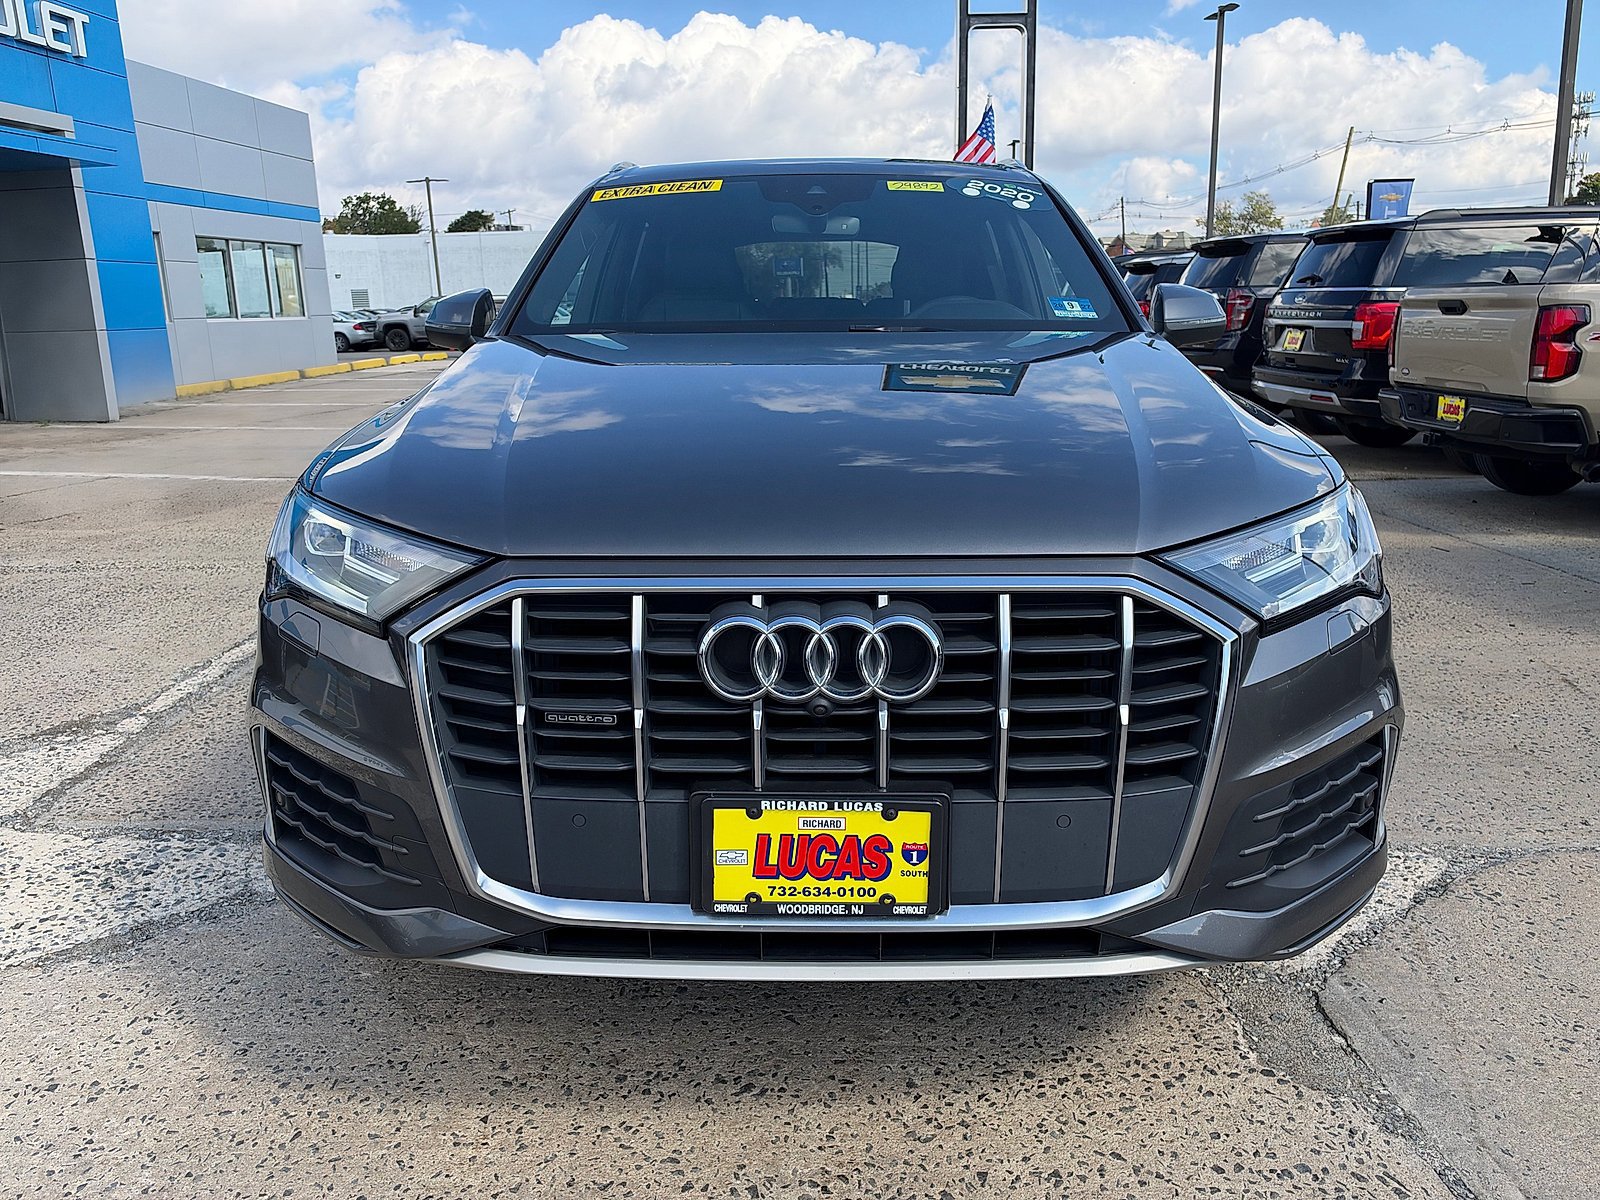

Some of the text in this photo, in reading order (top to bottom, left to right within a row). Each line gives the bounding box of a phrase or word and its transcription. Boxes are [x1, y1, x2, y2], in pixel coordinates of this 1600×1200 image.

[600, 180, 716, 199] EXTRA CLEAN
[966, 179, 1035, 203] 2020
[1067, 301, 1075, 310] 9
[1402, 326, 1509, 343] CHEVROLET
[1442, 402, 1461, 417] LUCAS
[547, 714, 613, 723] quattro
[760, 800, 884, 812] RICHARD LUCAS
[802, 819, 842, 829] RICHARD
[751, 833, 894, 882] LUCAS
[909, 850, 920, 864] 1
[900, 869, 929, 878] SOUTH
[767, 885, 877, 898] 732-634-0100
[713, 903, 748, 913] CHEVROLET
[776, 903, 864, 915] WOODBRIDGE, NJ
[892, 905, 928, 915] CHEVROLET
